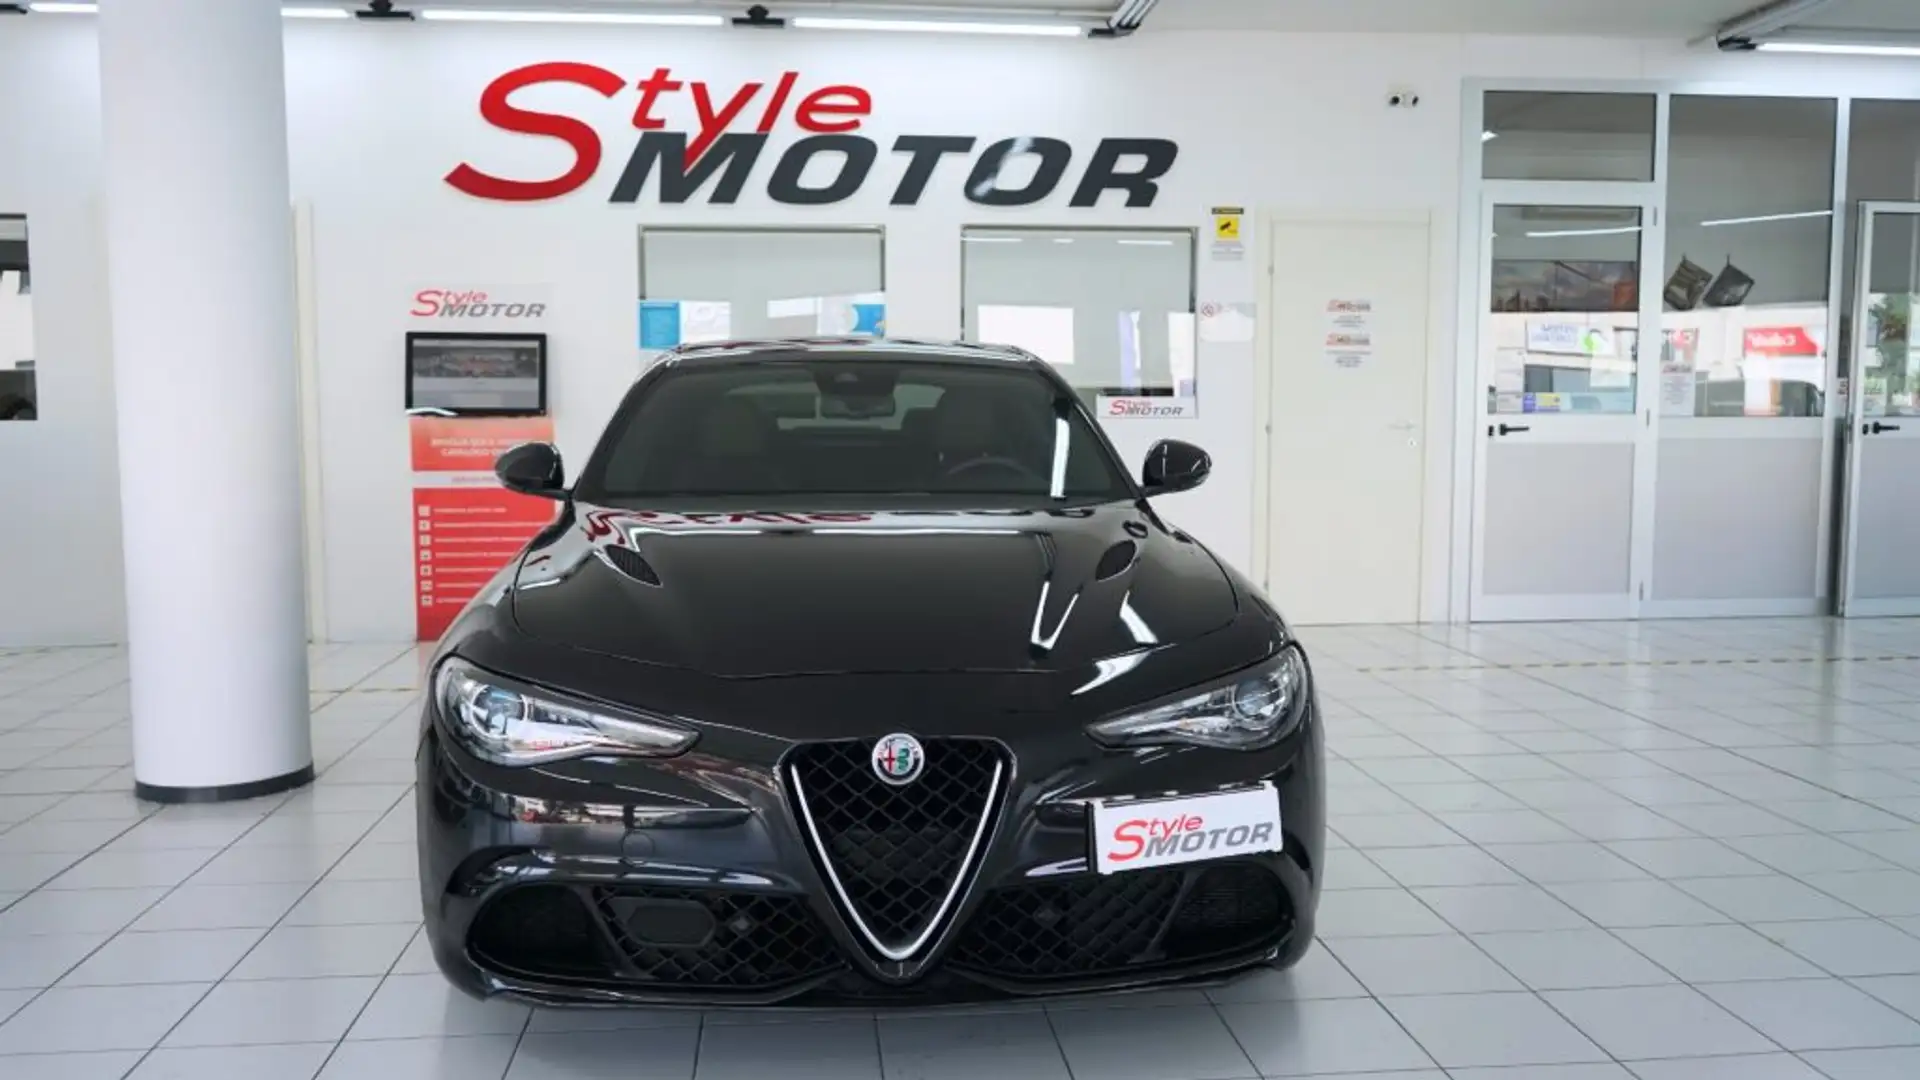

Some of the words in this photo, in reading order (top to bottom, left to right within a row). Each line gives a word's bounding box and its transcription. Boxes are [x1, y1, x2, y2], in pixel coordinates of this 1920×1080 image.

[443, 61, 872, 202] Style
[609, 131, 1180, 208] MOTOR
[409, 289, 488, 317] Style
[439, 303, 546, 318] MOTOR
[1107, 814, 1204, 863] Style
[1144, 821, 1274, 858] MOTOR
